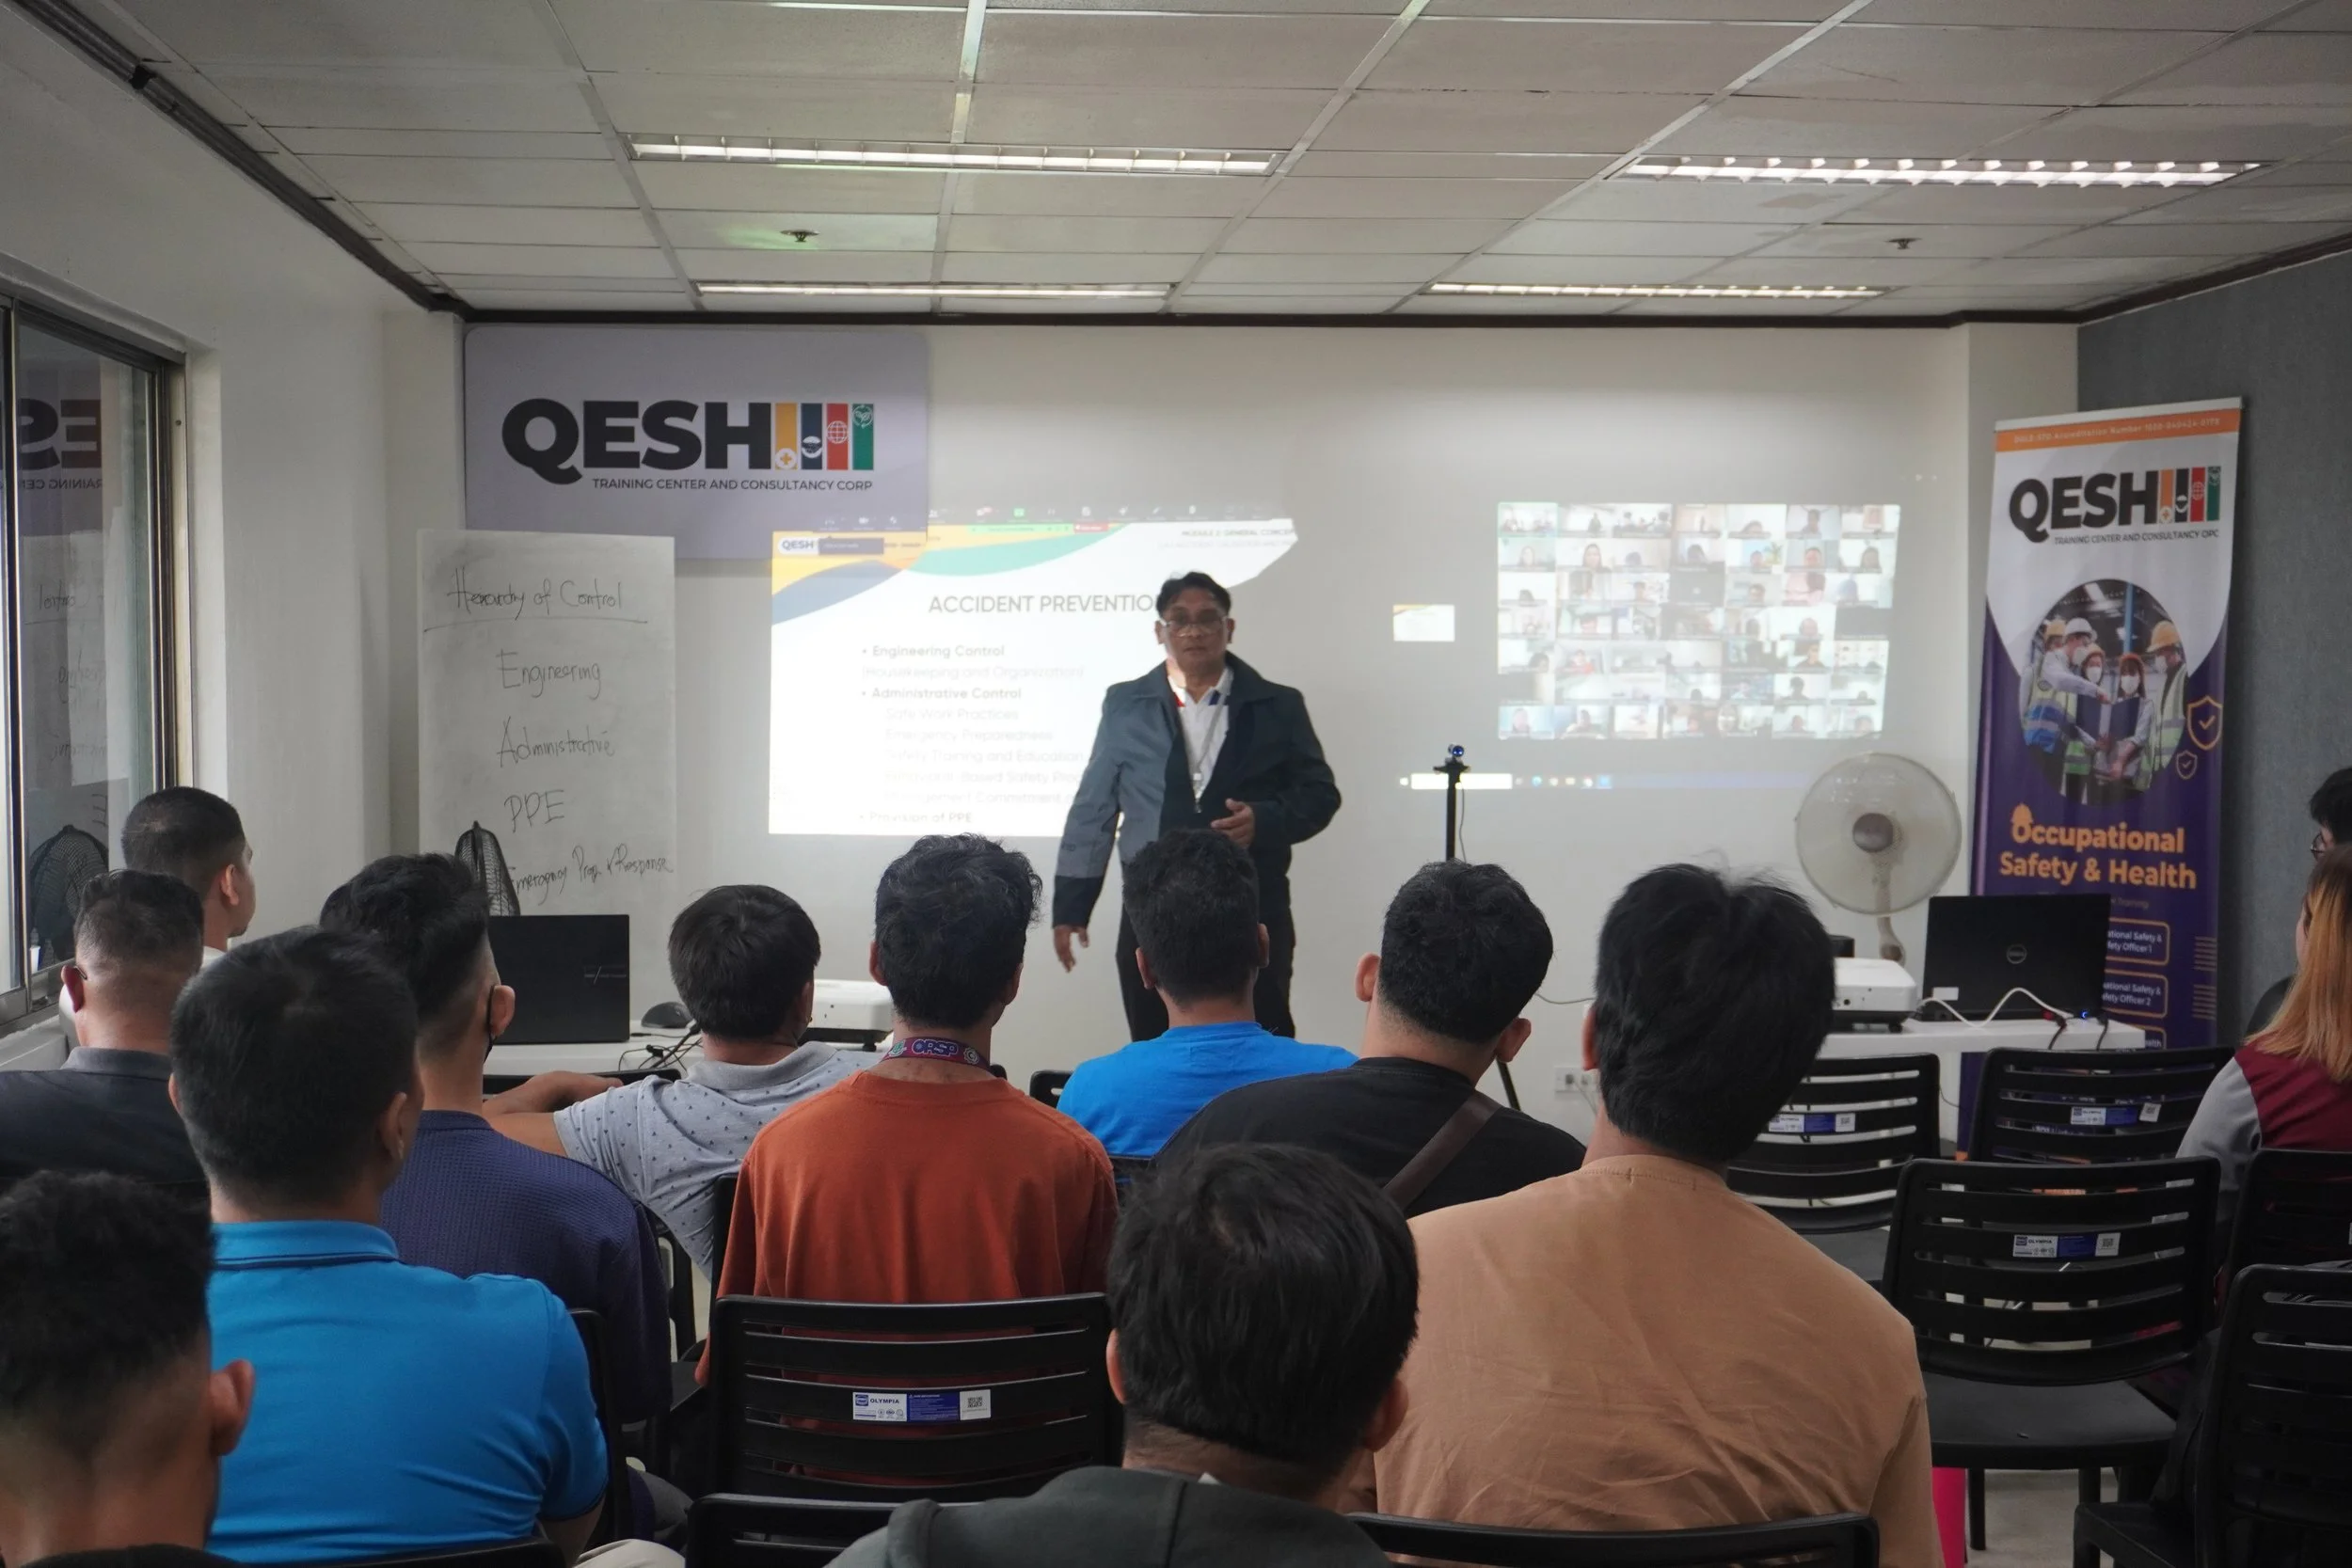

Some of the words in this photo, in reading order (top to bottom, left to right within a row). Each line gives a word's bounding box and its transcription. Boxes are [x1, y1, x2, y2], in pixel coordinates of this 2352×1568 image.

[502, 399, 771, 485] QESH
[593, 478, 653, 490] TRAINING
[658, 479, 707, 490] CENTER
[709, 479, 738, 490] AND
[740, 480, 834, 491] CONSULTANCY
[836, 480, 873, 491] CORP
[2009, 470, 2159, 544] QESH
[782, 539, 814, 551] QESH
[2054, 533, 2090, 546] TRAINING
[2091, 531, 2122, 544] CENTER
[2122, 531, 2141, 543] AND
[2142, 530, 2200, 543] CONSULTANCY
[533, 578, 551, 615] of
[561, 578, 622, 610] Control
[929, 595, 1034, 612] ACCIDENT
[872, 645, 950, 659] Engineering
[954, 645, 1005, 657] Control
[496, 648, 602, 701] Engineering
[871, 687, 968, 700] Administrative
[971, 687, 1023, 700] Control
[957, 708, 1019, 721] Practices
[961, 729, 1054, 743] Preparedness
[504, 789, 565, 832] PPE
[869, 812, 928, 823] Provision
[932, 812, 945, 823] of
[948, 811, 973, 823] PPE
[2011, 811, 2185, 854] Occupational
[1999, 850, 2077, 886] Safety
[2083, 857, 2103, 883] &
[2108, 860, 2198, 890] Health
[2133, 931, 2155, 943] Safety
[2122, 942, 2146, 954] Officer
[2132, 983, 2155, 996] Safety
[2120, 993, 2145, 1006] Officer
